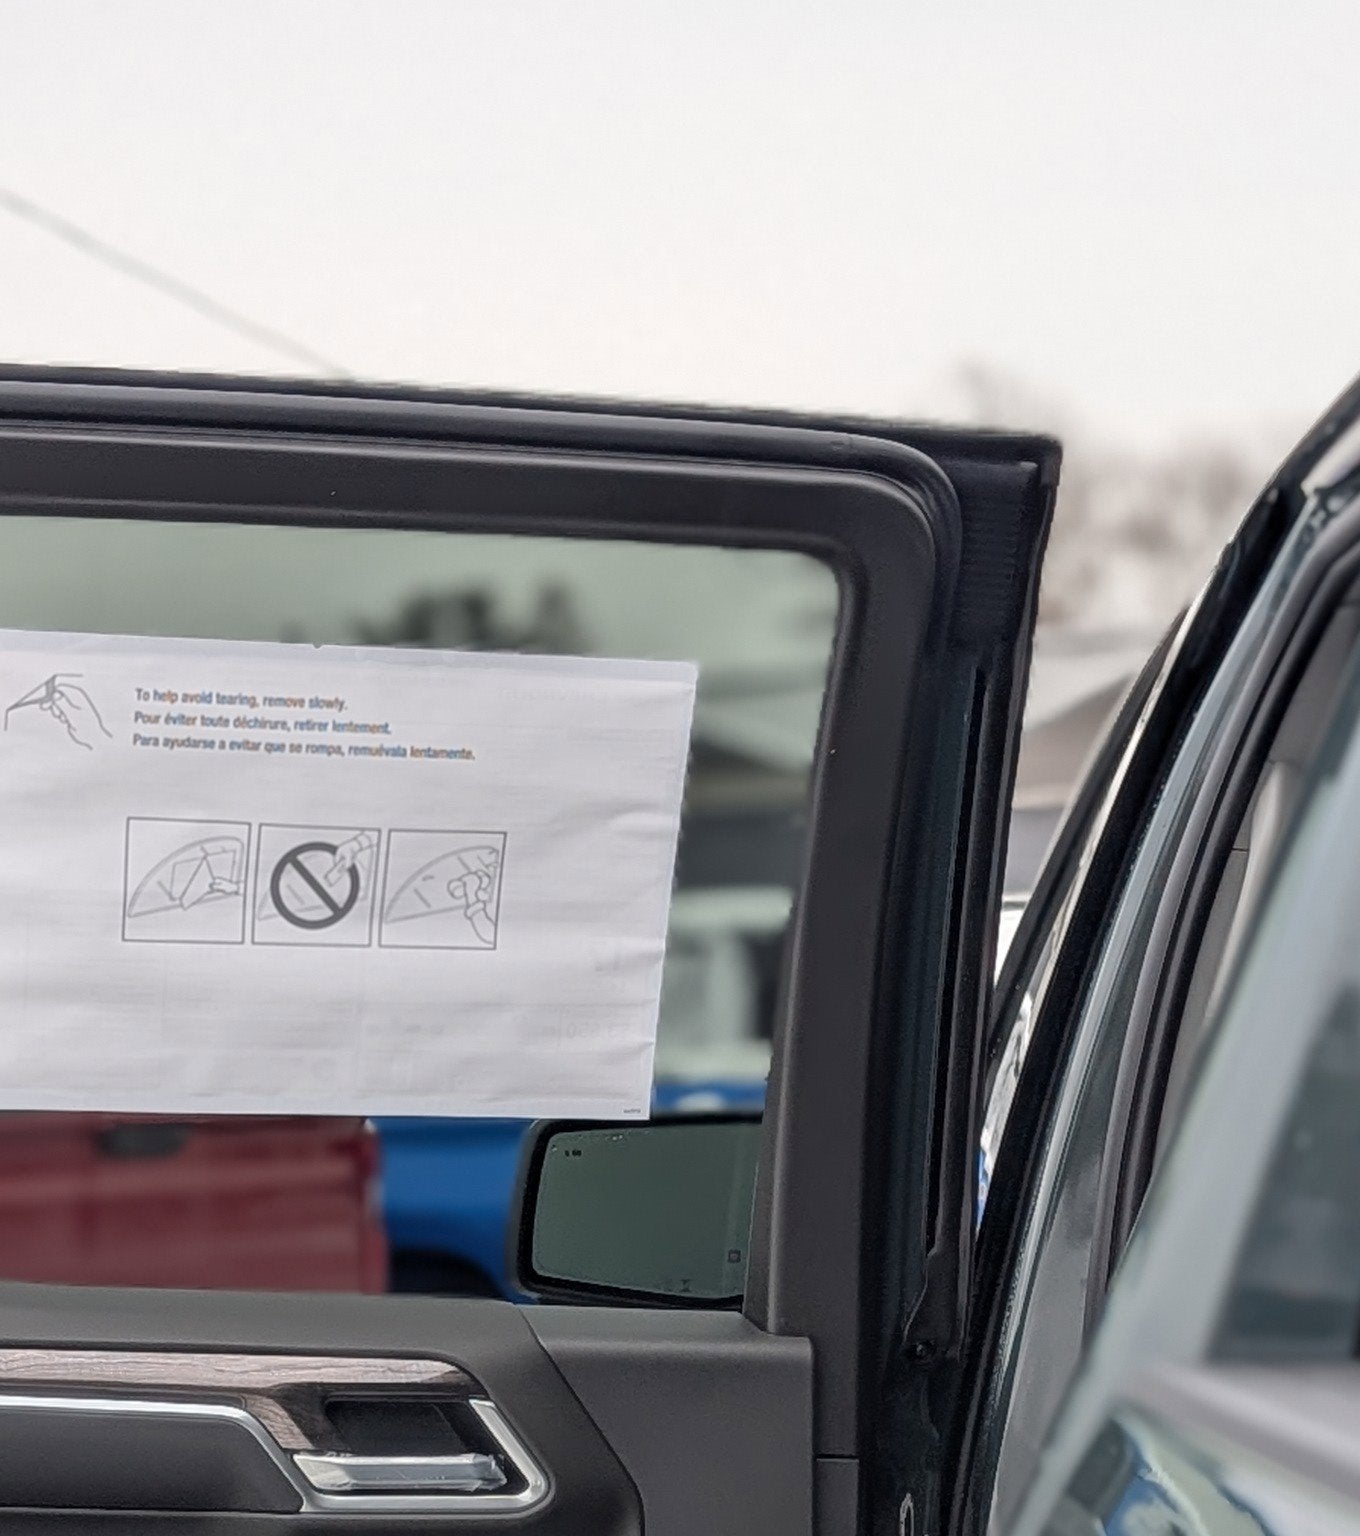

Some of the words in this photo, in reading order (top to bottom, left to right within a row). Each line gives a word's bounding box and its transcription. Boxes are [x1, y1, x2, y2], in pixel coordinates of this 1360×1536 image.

[135, 688, 151, 701] To
[153, 689, 178, 705] help
[181, 691, 213, 705] avoid
[216, 692, 260, 709] tearing,
[262, 697, 306, 708] remove
[308, 696, 348, 713] slowly.
[134, 711, 160, 724] Pour
[164, 712, 197, 726] éviter
[200, 715, 230, 728] toute
[233, 715, 291, 732] déchirure,
[294, 719, 329, 732] retirer
[133, 733, 159, 747] Para
[162, 737, 215, 750] ayudarse
[218, 739, 226, 750] a
[229, 738, 262, 751] evitar
[265, 742, 286, 754] que
[289, 743, 303, 754] se
[305, 743, 345, 757] rompa,
[410, 746, 476, 760] lentamente.
